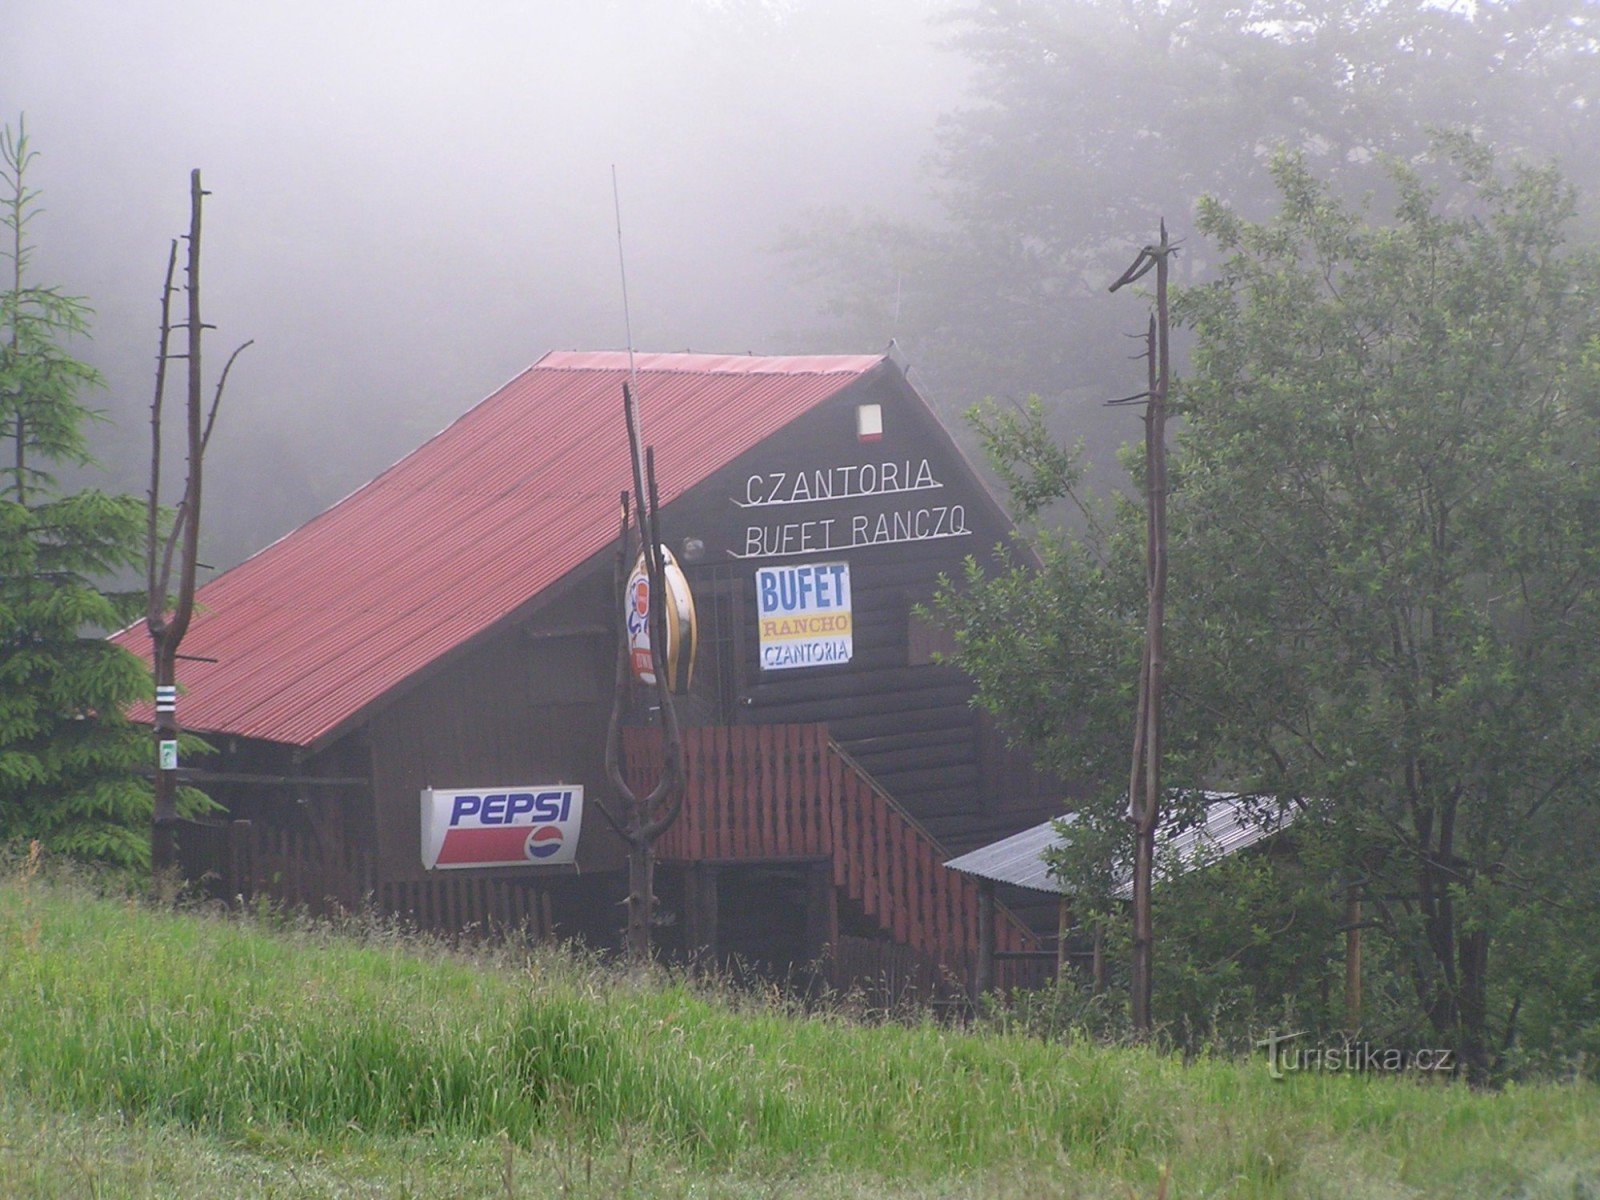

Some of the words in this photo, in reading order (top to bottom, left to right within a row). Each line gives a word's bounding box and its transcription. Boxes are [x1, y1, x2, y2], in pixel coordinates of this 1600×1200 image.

[747, 459, 934, 505] CZANTORIA
[746, 519, 835, 556] BUFET
[852, 505, 965, 547] RANCZO
[760, 565, 846, 613] BUFET
[763, 615, 848, 637] RANCHO
[764, 642, 849, 666] CZANTORIA
[450, 792, 572, 826] PEPSI
